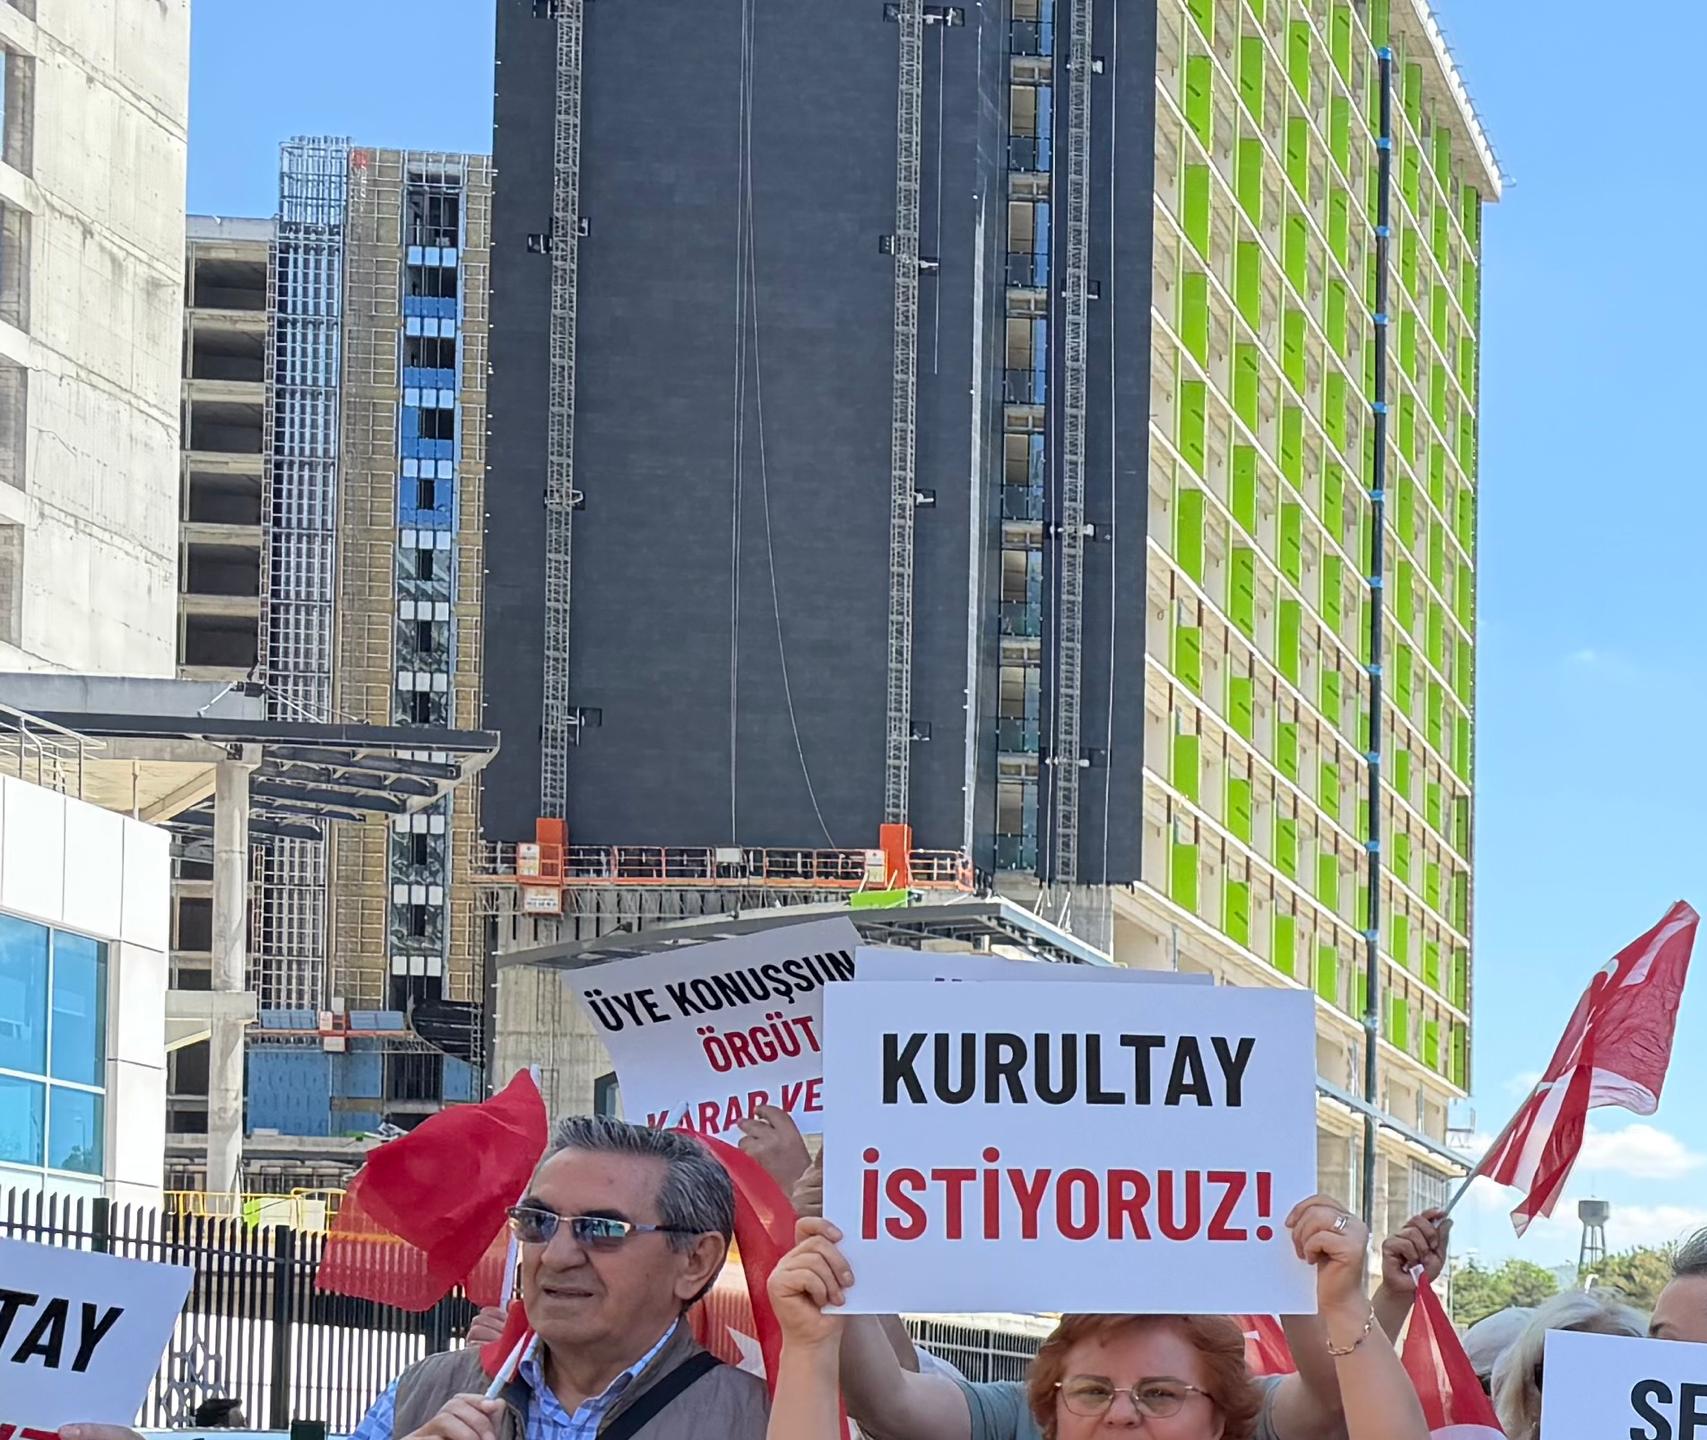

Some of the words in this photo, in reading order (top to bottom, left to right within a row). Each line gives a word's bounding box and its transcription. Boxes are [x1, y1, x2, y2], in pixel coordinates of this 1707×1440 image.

[584, 988, 671, 1032] ÜYE
[665, 950, 856, 1017] KONUŞSUN
[697, 1011, 821, 1073] ÖRGÜT
[883, 1033, 1255, 1107] KURULTAY
[862, 1147, 1273, 1240] İSTİYORUZ!
